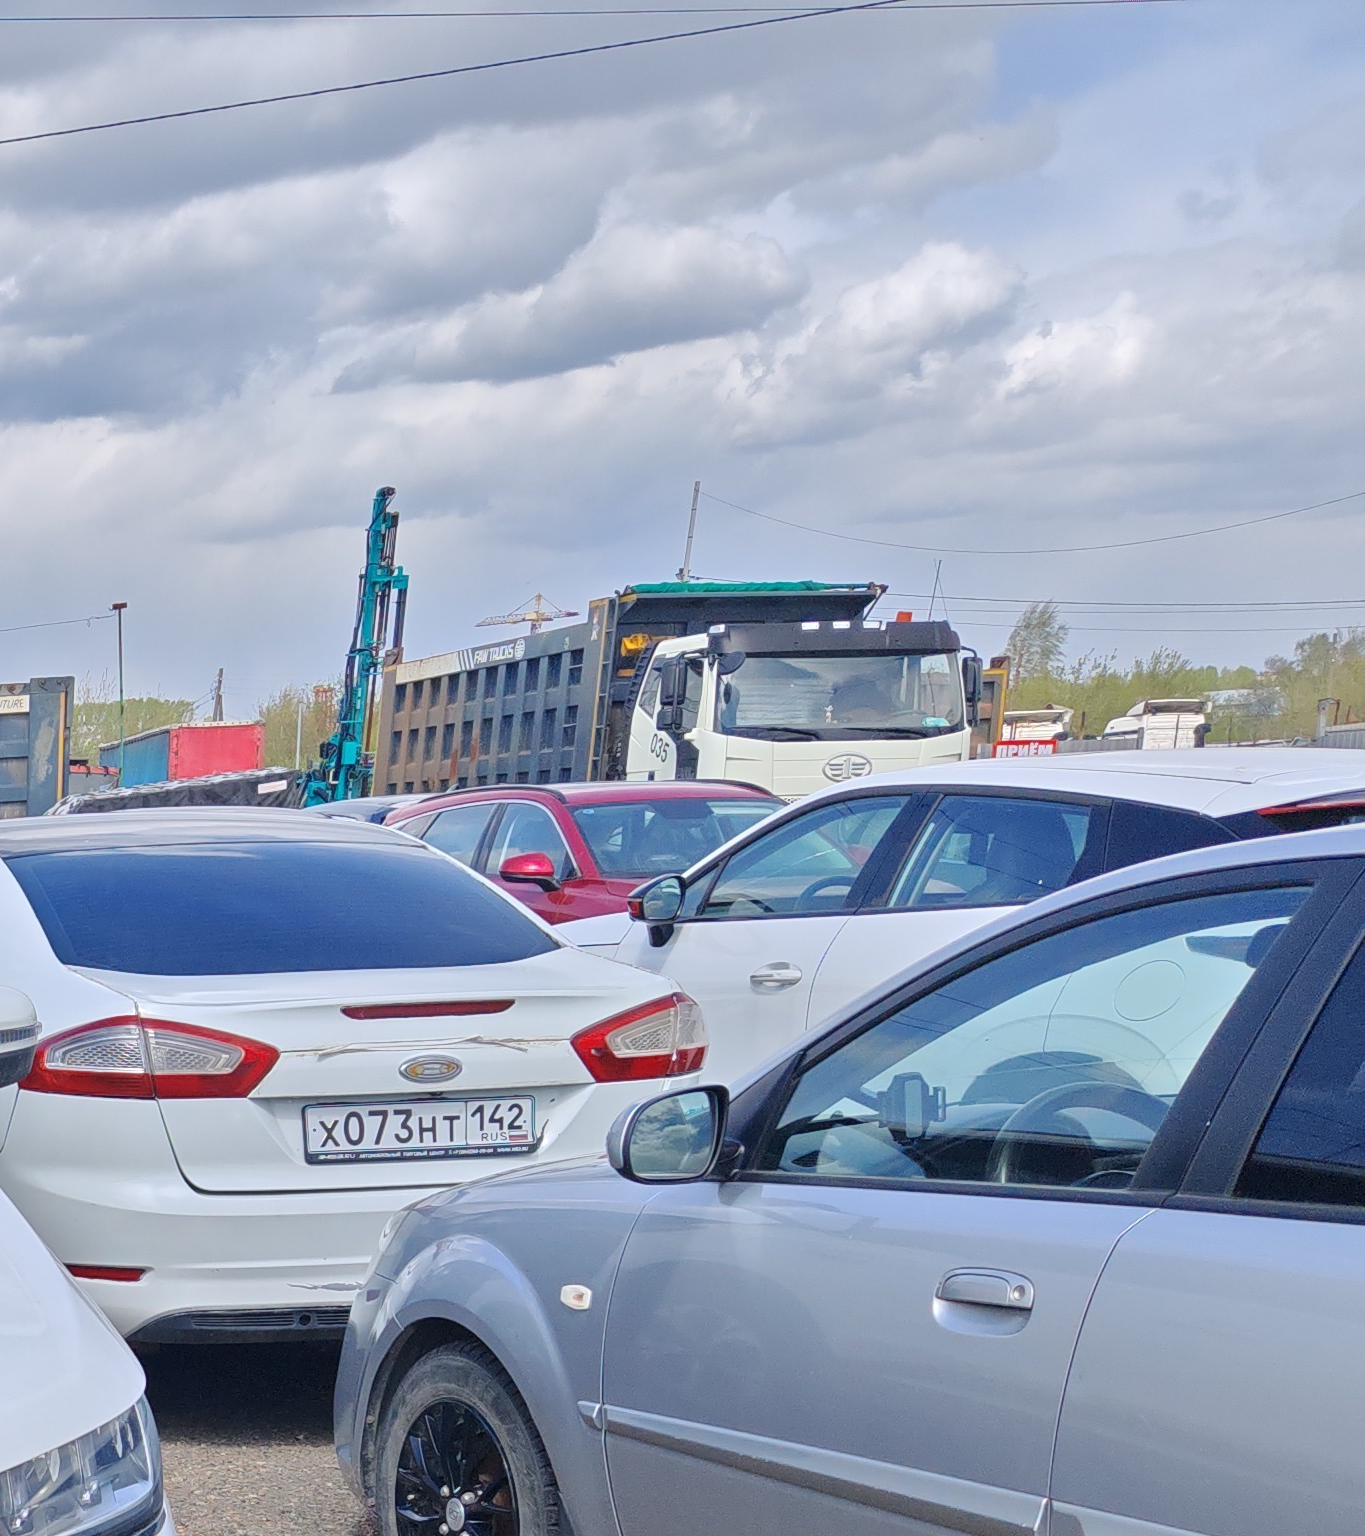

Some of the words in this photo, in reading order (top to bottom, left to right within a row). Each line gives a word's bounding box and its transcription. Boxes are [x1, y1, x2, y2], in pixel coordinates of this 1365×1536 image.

[650, 733, 670, 763] 035
[319, 1109, 461, 1148] Х073НТ
[470, 1103, 523, 1132] 142
[481, 1132, 507, 1142] RUS
